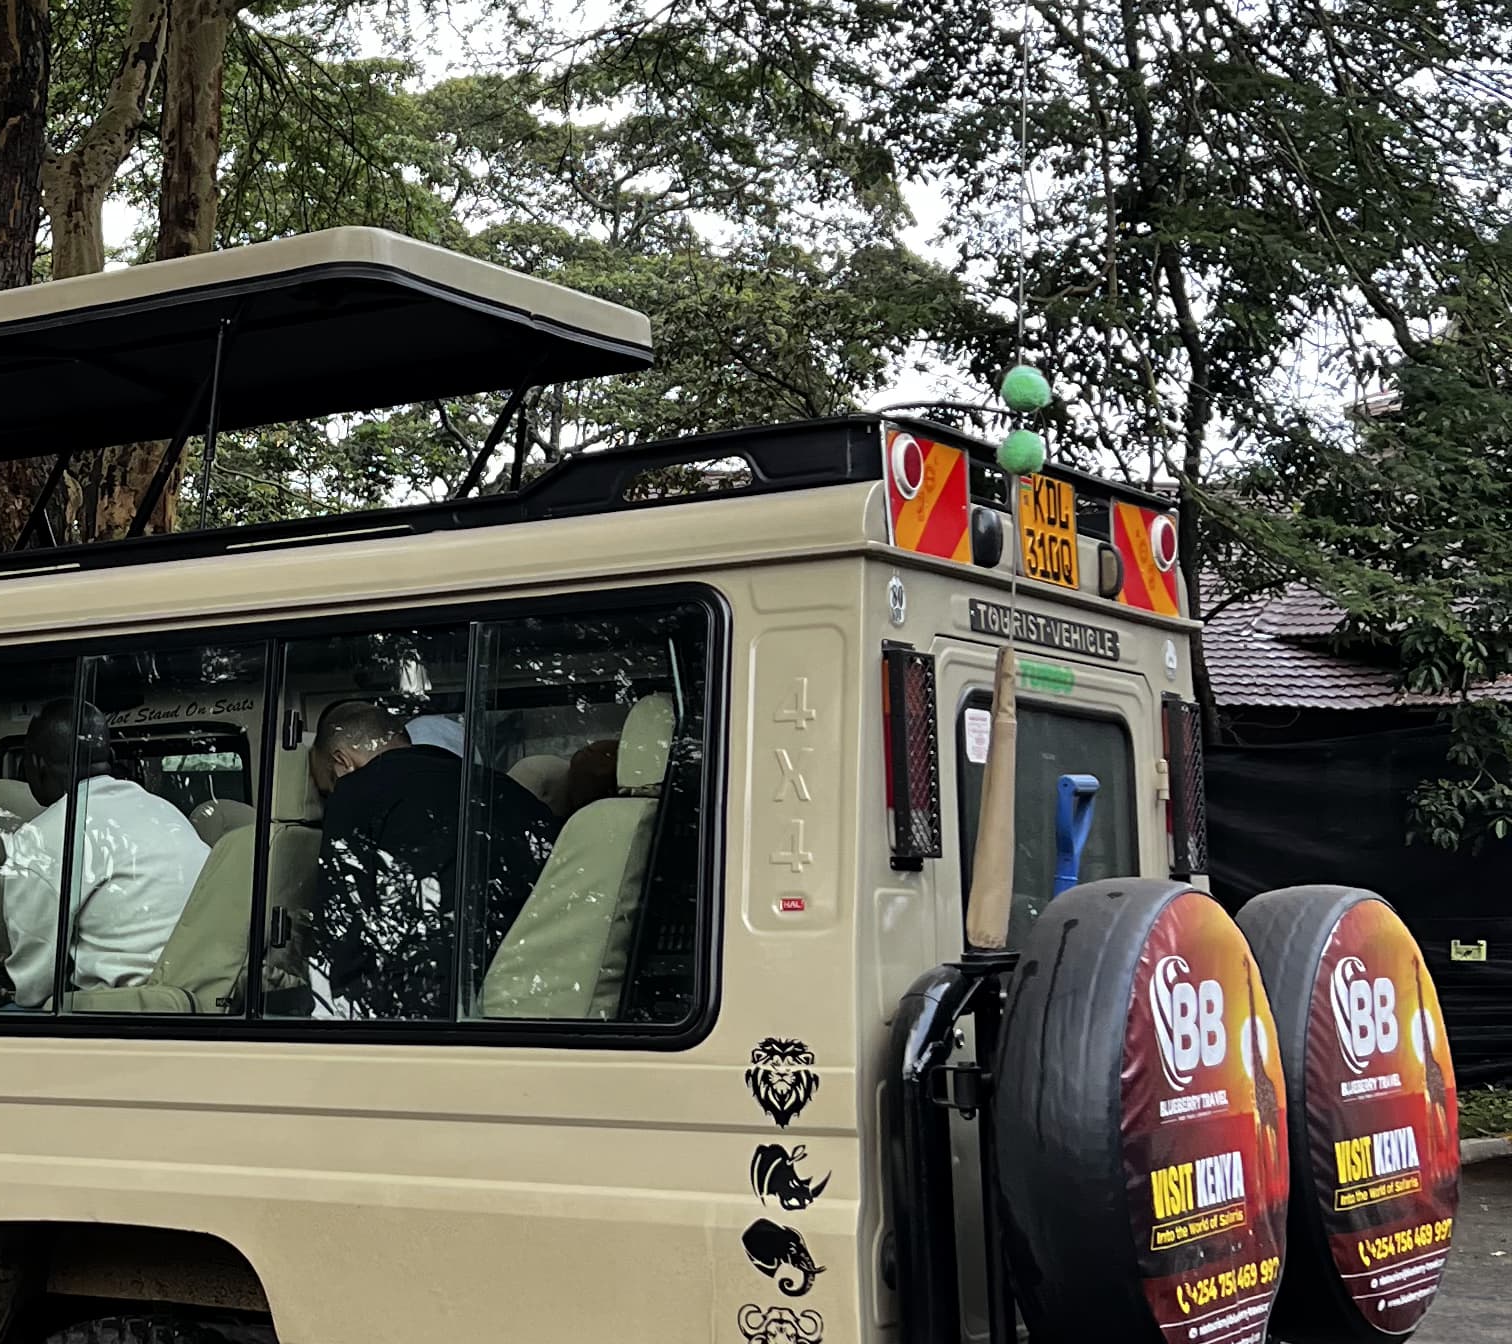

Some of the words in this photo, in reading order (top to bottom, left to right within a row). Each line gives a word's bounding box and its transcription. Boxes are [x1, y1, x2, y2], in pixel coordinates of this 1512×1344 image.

[1032, 474, 1070, 529] KDL
[1025, 529, 1073, 584] 310Q
[977, 603, 1046, 641] TOURIST
[1051, 618, 1115, 656] VEHICLE
[135, 706, 180, 722] Stand
[186, 702, 207, 716] On
[212, 698, 254, 715] Seats
[1335, 1135, 1373, 1184] VISIT
[1373, 1126, 1420, 1176] KENYA
[1150, 1162, 1194, 1219] VISIT
[1195, 1151, 1245, 1208] KENYA
[1156, 1229, 1174, 1245] Into
[1174, 1223, 1188, 1242] the
[1188, 1219, 1209, 1237] World
[1219, 1209, 1244, 1227] Safaris
[1395, 1229, 1413, 1254] 756
[1414, 1223, 1433, 1248] 469
[1237, 1262, 1257, 1289] 469
